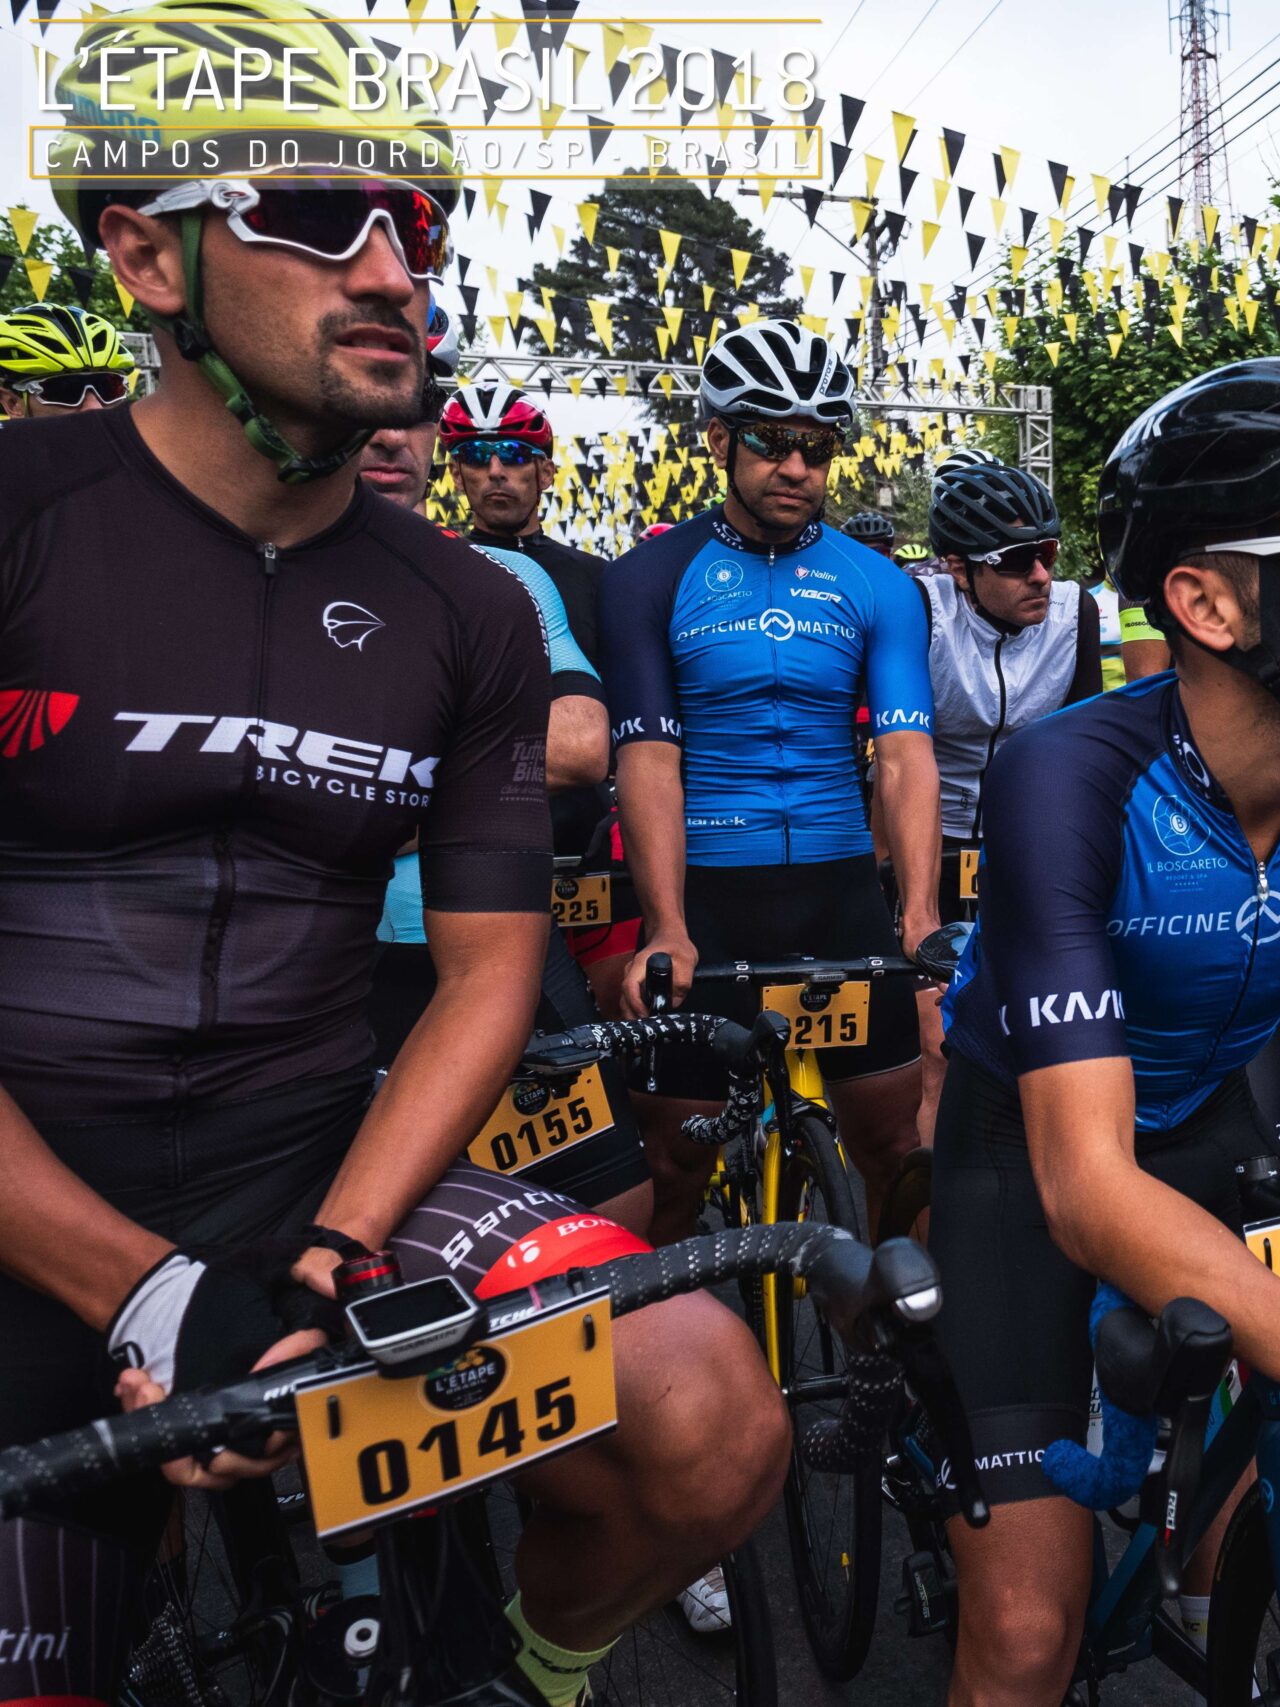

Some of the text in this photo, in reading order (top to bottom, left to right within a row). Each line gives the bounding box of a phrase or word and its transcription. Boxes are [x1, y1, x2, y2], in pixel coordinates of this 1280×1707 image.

[810, 569, 838, 582] Nalini
[789, 587, 842, 604] VIGOR
[675, 618, 757, 643] OFFICINE
[876, 708, 930, 729] KASK
[112, 711, 443, 789] TREK
[255, 764, 377, 802] BICYCLE
[1156, 857, 1229, 872] BOSCARETO
[1106, 911, 1232, 937] OFFICINE
[1029, 989, 1126, 1028] KASK
[785, 1013, 858, 1046] 215
[489, 1096, 594, 1172] 0155
[356, 1375, 577, 1506] 0145
